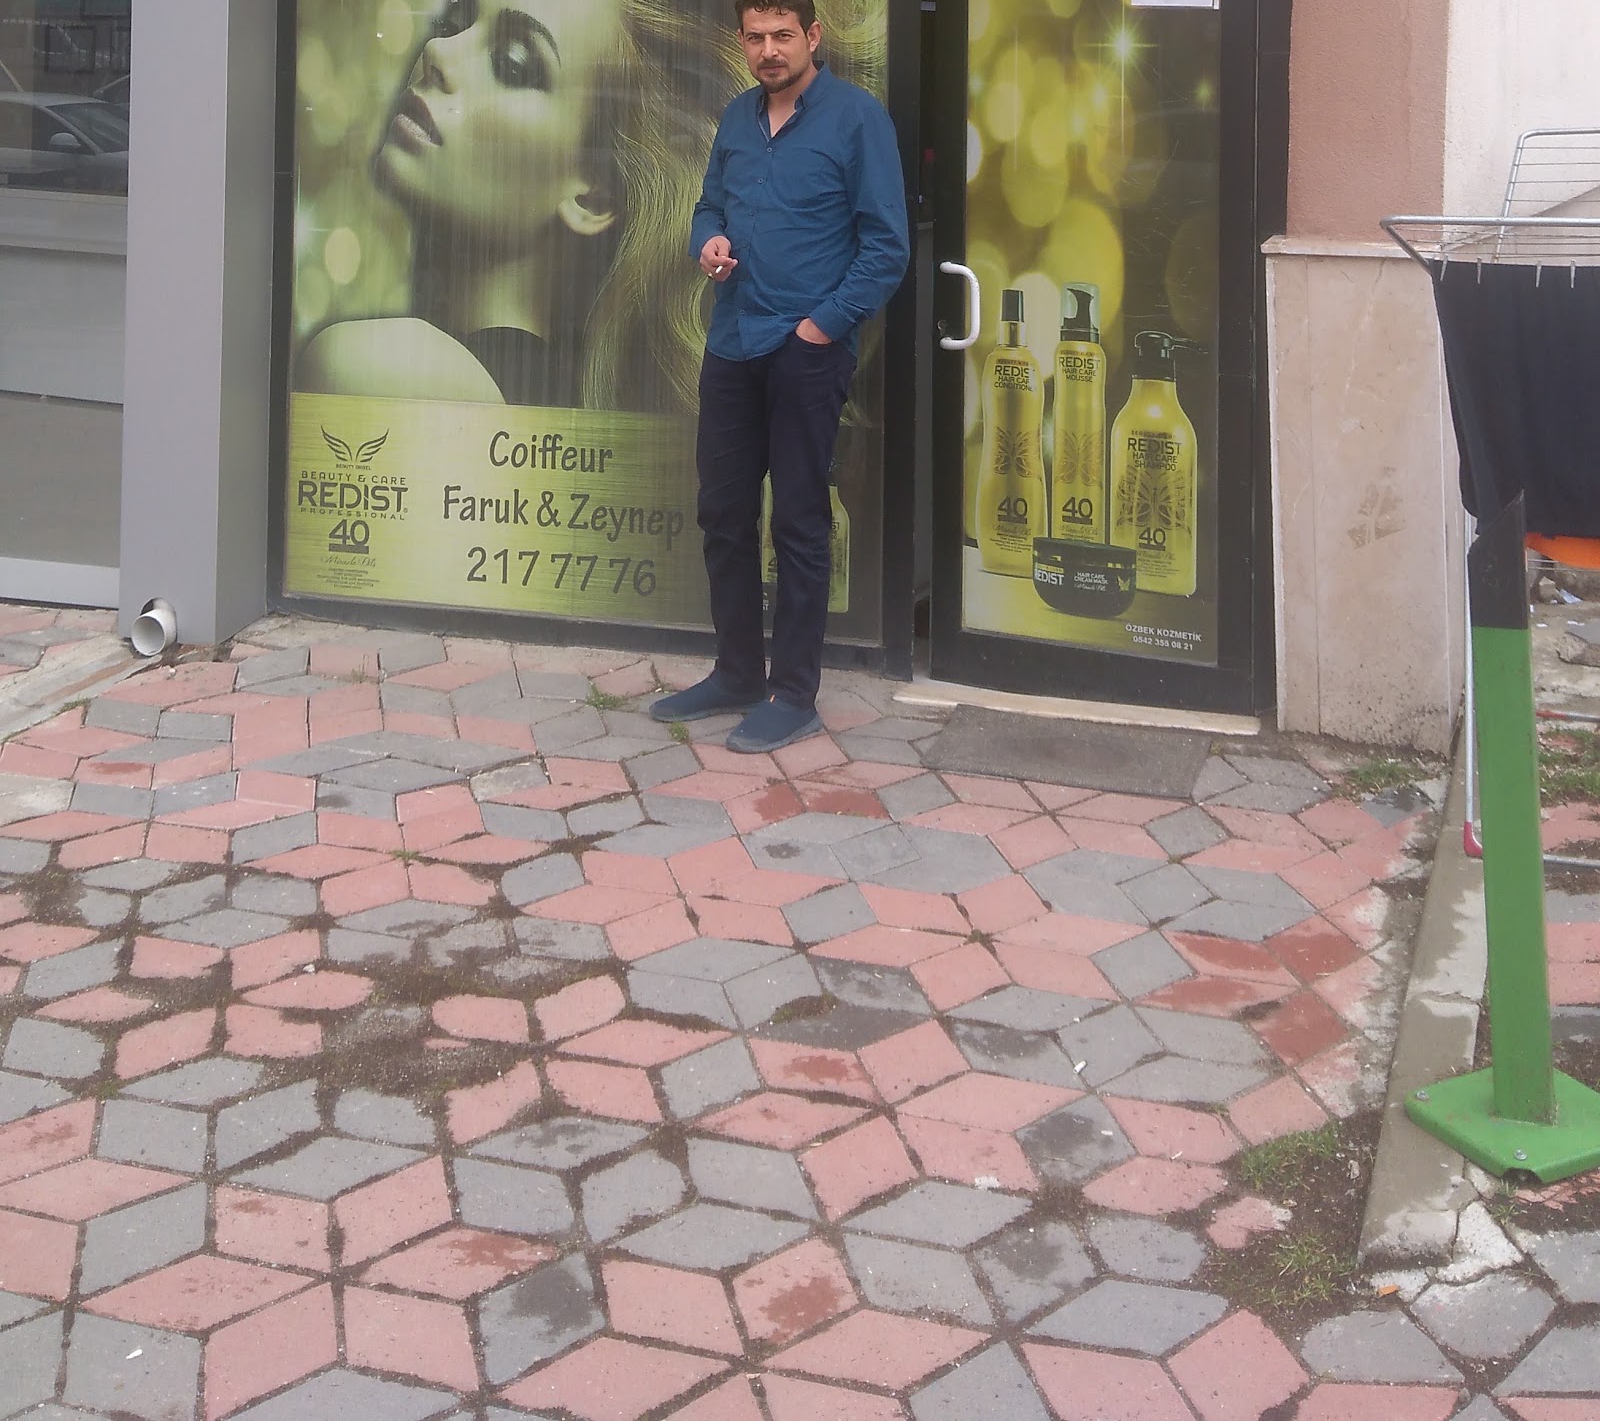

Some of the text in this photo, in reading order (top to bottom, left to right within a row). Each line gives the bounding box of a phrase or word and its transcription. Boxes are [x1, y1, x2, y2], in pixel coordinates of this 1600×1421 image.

[995, 365, 1035, 378] REDIS
[1059, 357, 1100, 369] REDIST
[489, 431, 612, 473] Coiffeur
[1128, 438, 1182, 455] REDIST
[1156, 454, 1177, 463] CARE
[302, 471, 351, 481] BEAUTY
[371, 476, 406, 485] CARE
[298, 480, 408, 512] REDIST
[301, 508, 404, 520] PROFESSIONAL
[998, 497, 1027, 517] 40
[1062, 497, 1093, 518] 40
[443, 485, 684, 550] Faruk & Zeynep
[329, 519, 369, 545] 40
[1139, 527, 1166, 545] 40
[467, 547, 656, 597] 217 77 76
[1125, 623, 1202, 641] ÖZBEK KOZMETİK
[1133, 635, 1153, 645] 0542
